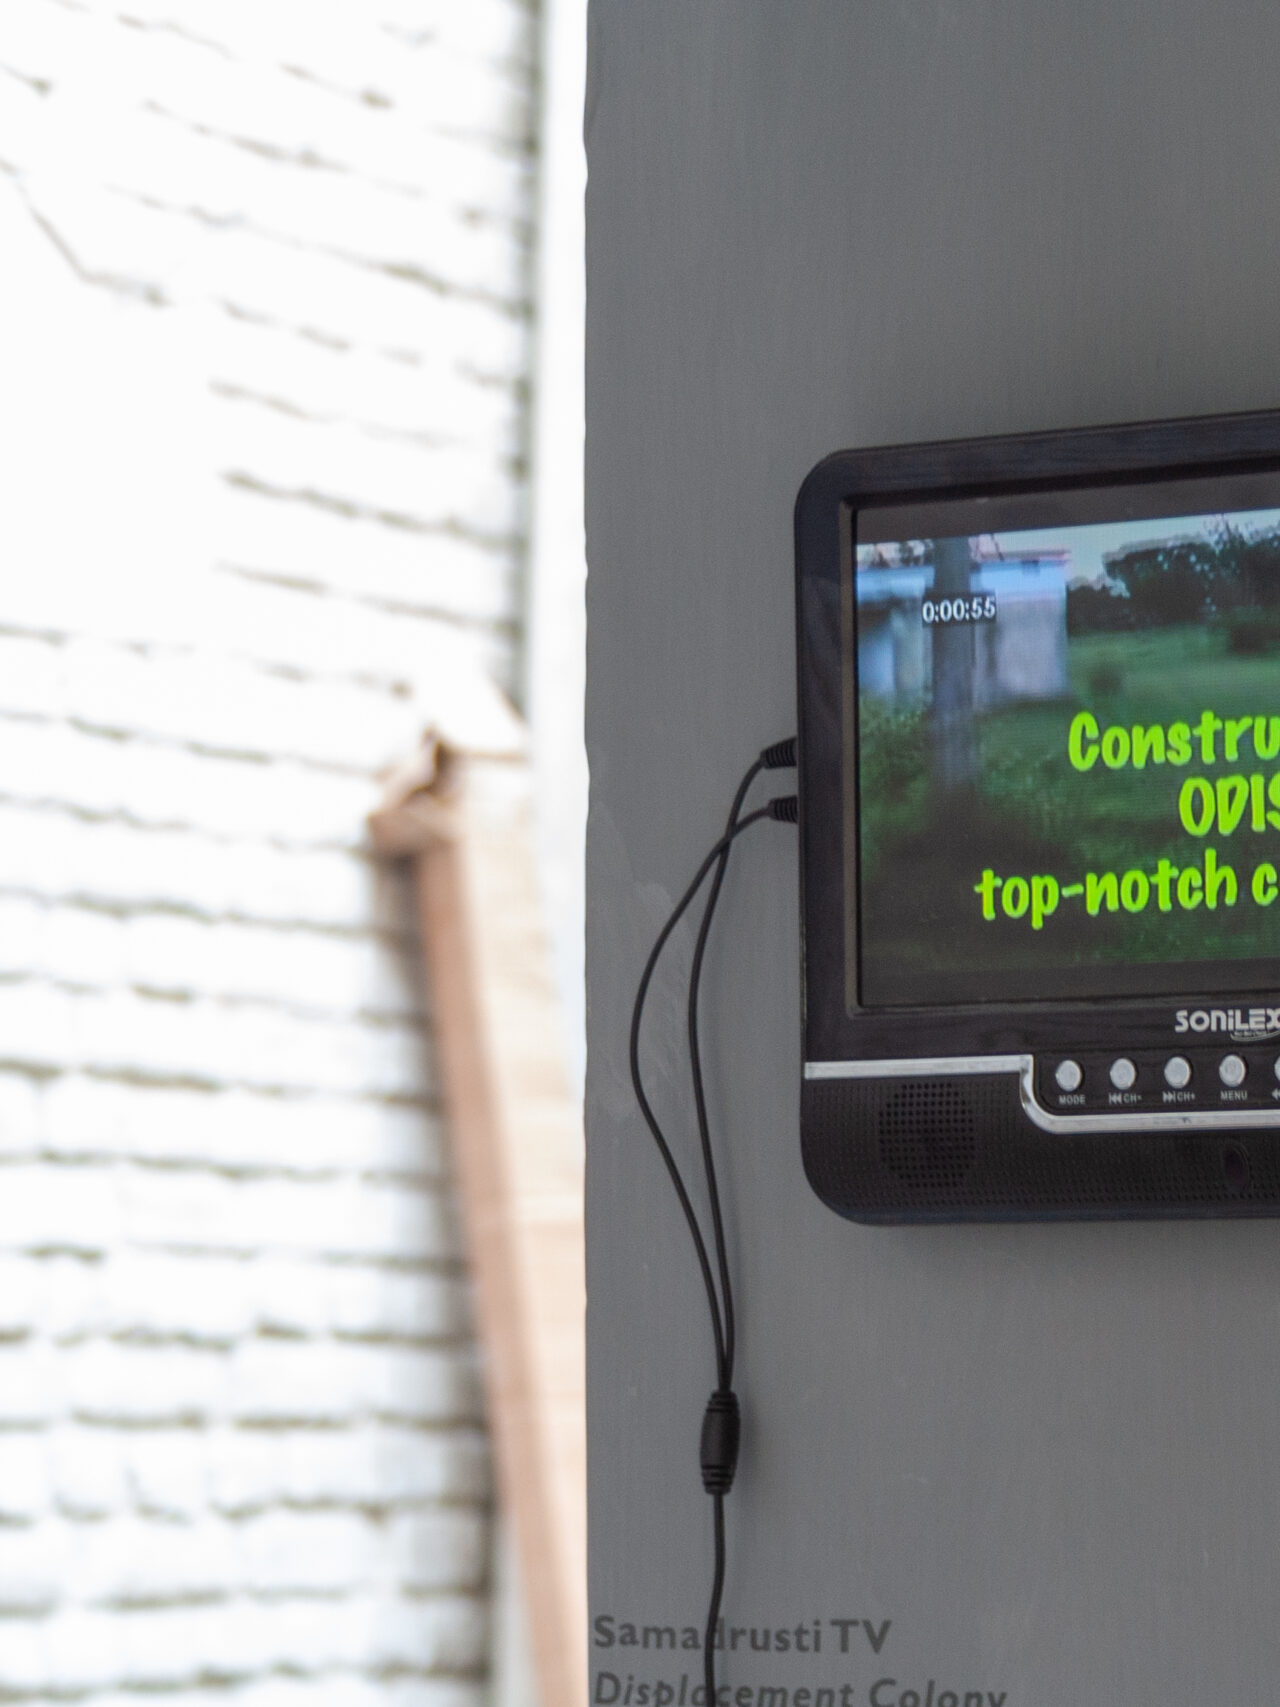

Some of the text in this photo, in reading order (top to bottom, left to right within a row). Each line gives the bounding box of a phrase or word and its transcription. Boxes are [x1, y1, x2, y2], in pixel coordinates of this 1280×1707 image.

[922, 596, 996, 624] 0:00:55
[974, 848, 1237, 930] top-notch
[1058, 1094, 1086, 1105] MODE
[1176, 1092, 1196, 1101] CH+
[1220, 1090, 1248, 1100] MENU
[593, 1614, 893, 1655] Samadrusti TV
